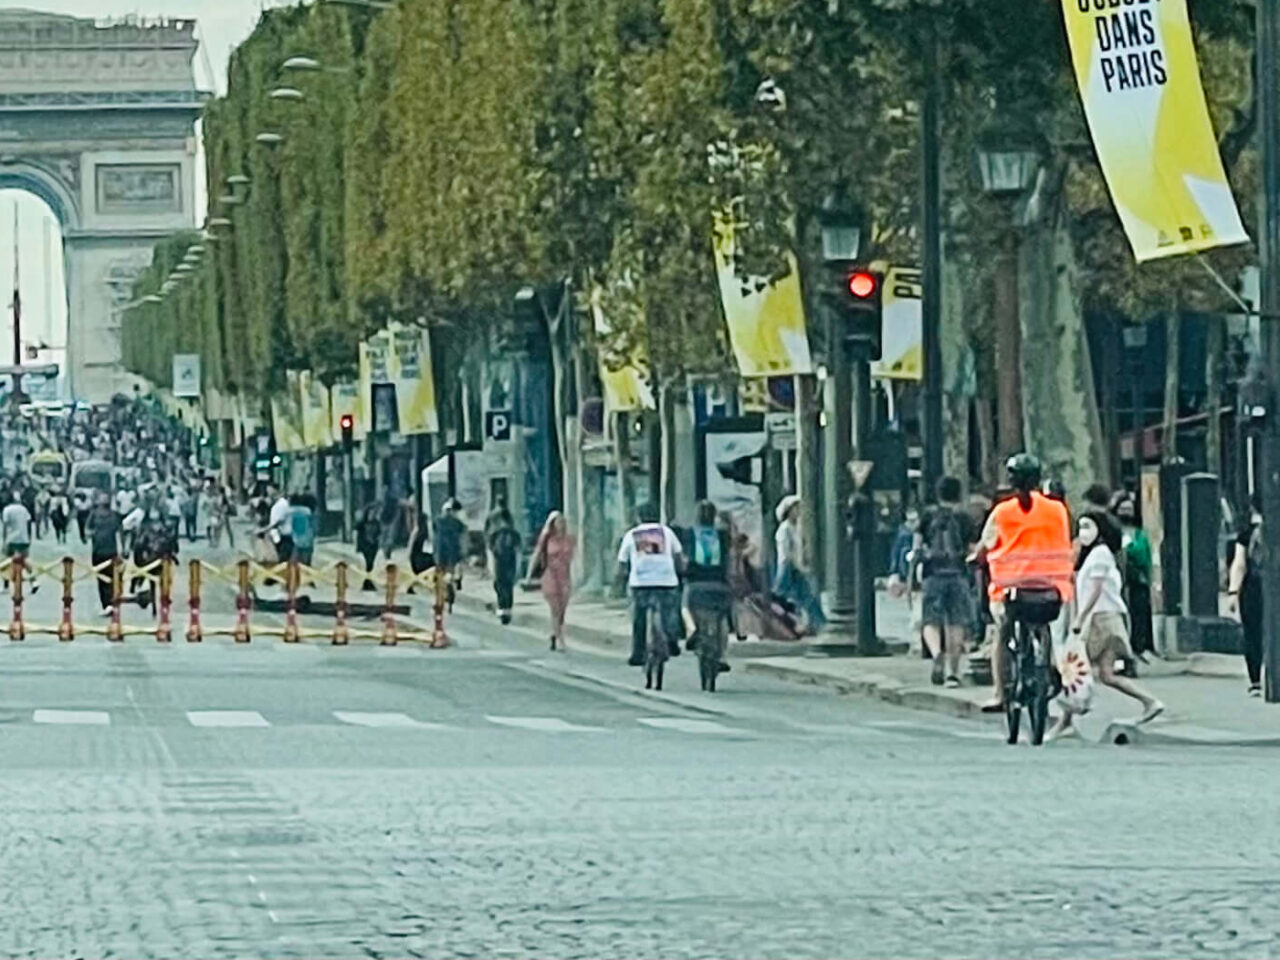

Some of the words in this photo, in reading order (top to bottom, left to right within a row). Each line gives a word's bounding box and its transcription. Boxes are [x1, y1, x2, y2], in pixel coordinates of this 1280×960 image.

[1095, 9, 1155, 52] DANS
[1101, 50, 1167, 93] PARIS
[492, 414, 507, 437] P
